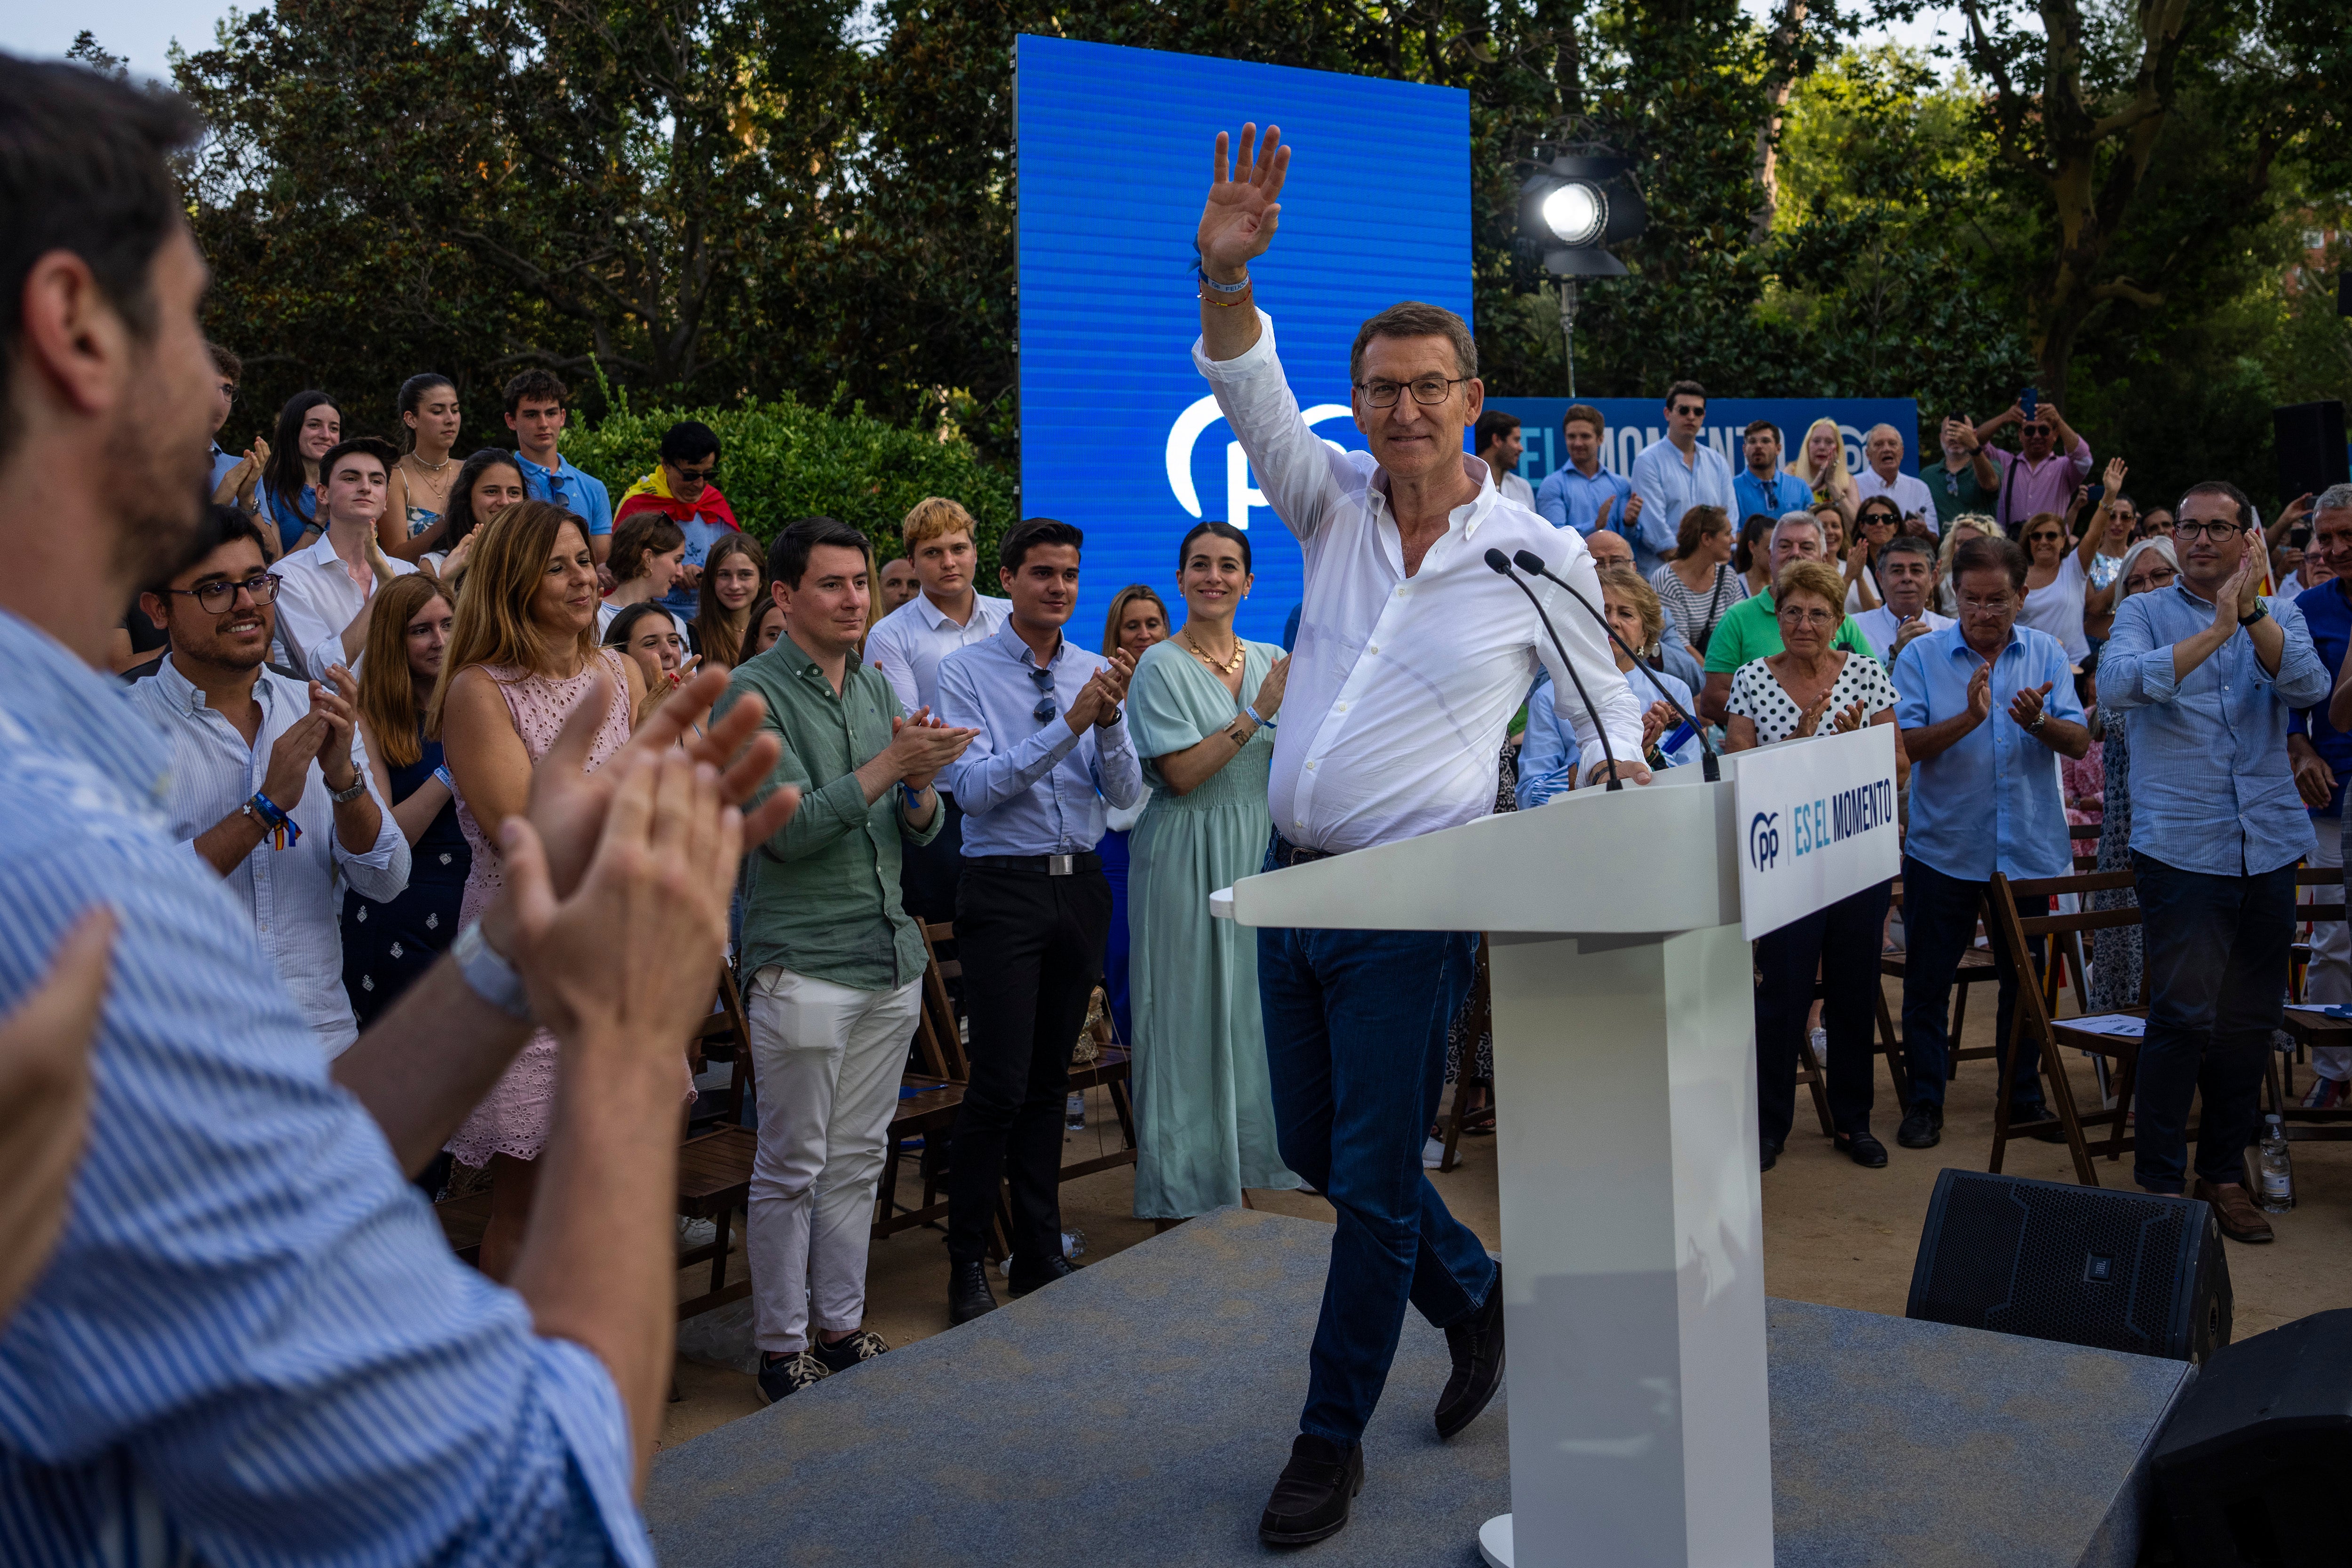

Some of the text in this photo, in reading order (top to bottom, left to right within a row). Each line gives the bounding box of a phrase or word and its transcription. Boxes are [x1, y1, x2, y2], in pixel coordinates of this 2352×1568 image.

[1794, 778, 1891, 856] ES EL MOMENTO
[2095, 1261, 2106, 1274] JBL
